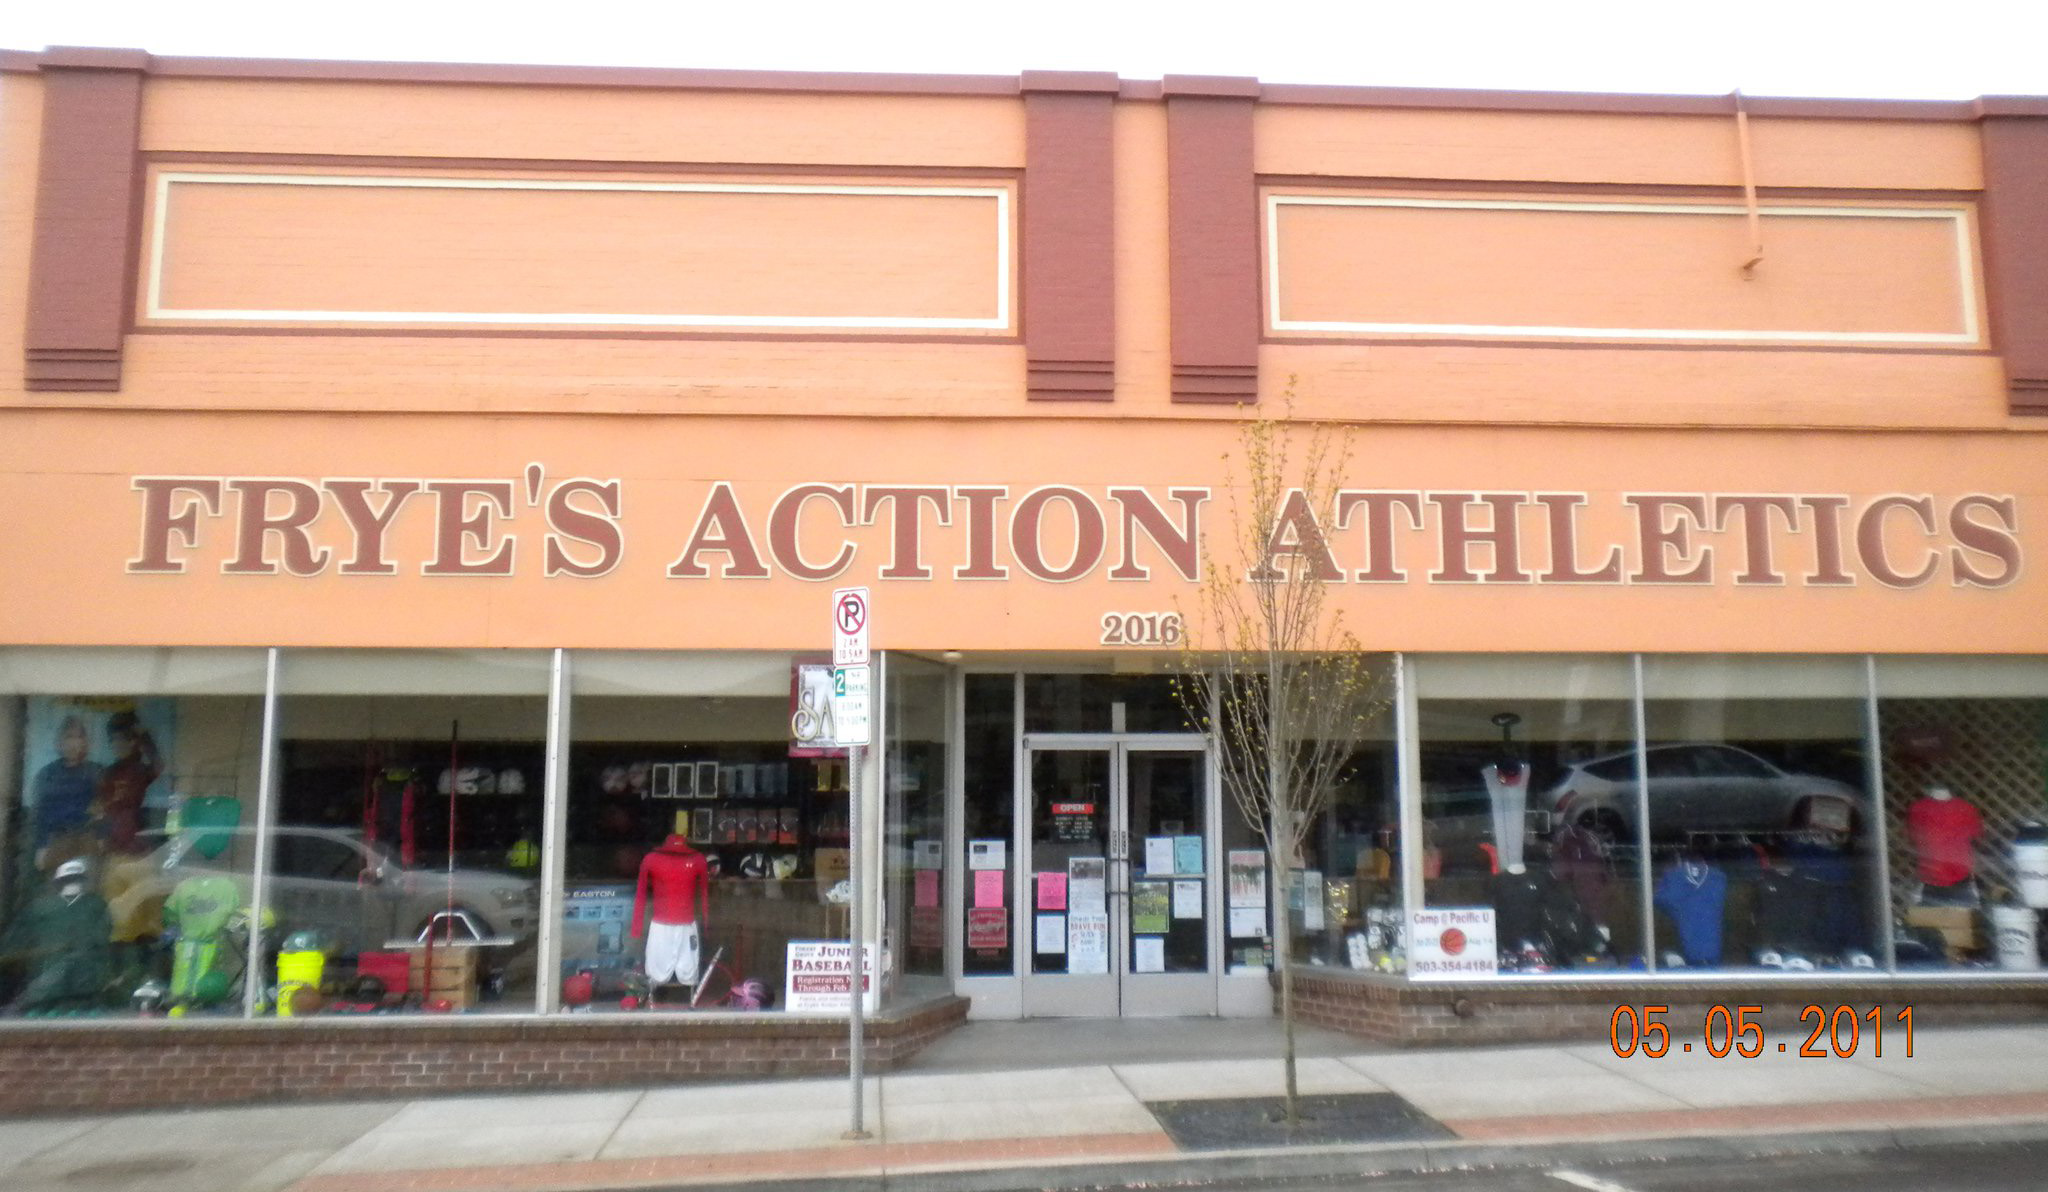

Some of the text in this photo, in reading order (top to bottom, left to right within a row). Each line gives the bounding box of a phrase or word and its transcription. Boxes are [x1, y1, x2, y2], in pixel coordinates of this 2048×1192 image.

[125, 461, 2023, 590] FRYE'S ACTION ATHLETICS
[1100, 611, 1181, 645] 2016
[836, 673, 845, 693] 2
[573, 890, 616, 898] EASTON
[1413, 913, 1440, 926] Camp
[1449, 912, 1480, 924] Pacific
[1483, 912, 1489, 922] U
[818, 946, 868, 957] JUNIR
[792, 960, 872, 971] BASEBAL
[1415, 960, 1494, 973] 503-354-4184
[797, 976, 844, 986] Registration
[799, 985, 831, 994] Through
[833, 985, 847, 993] Feb
